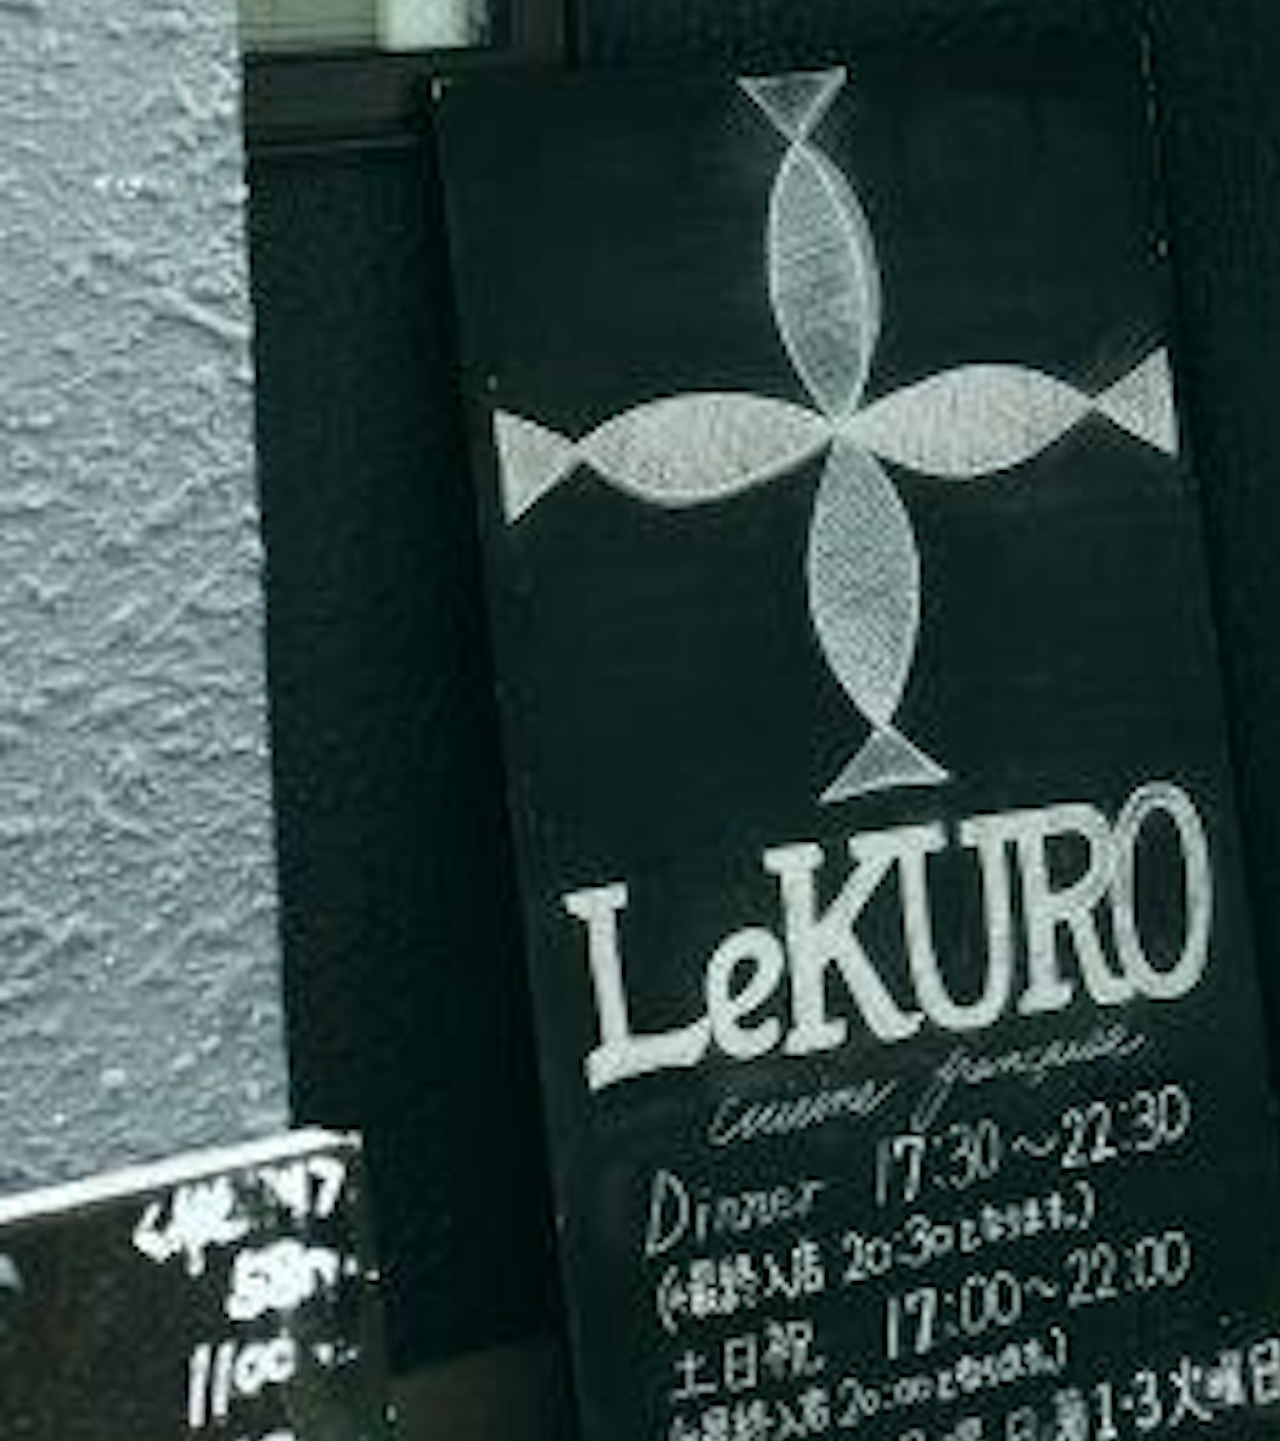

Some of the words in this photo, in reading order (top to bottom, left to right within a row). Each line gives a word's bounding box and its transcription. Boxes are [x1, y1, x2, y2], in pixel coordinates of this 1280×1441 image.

[562, 779, 1214, 1091] LeKURO
[645, 1168, 826, 1257] Dinner
[671, 1318, 827, 1401] 土日祝
